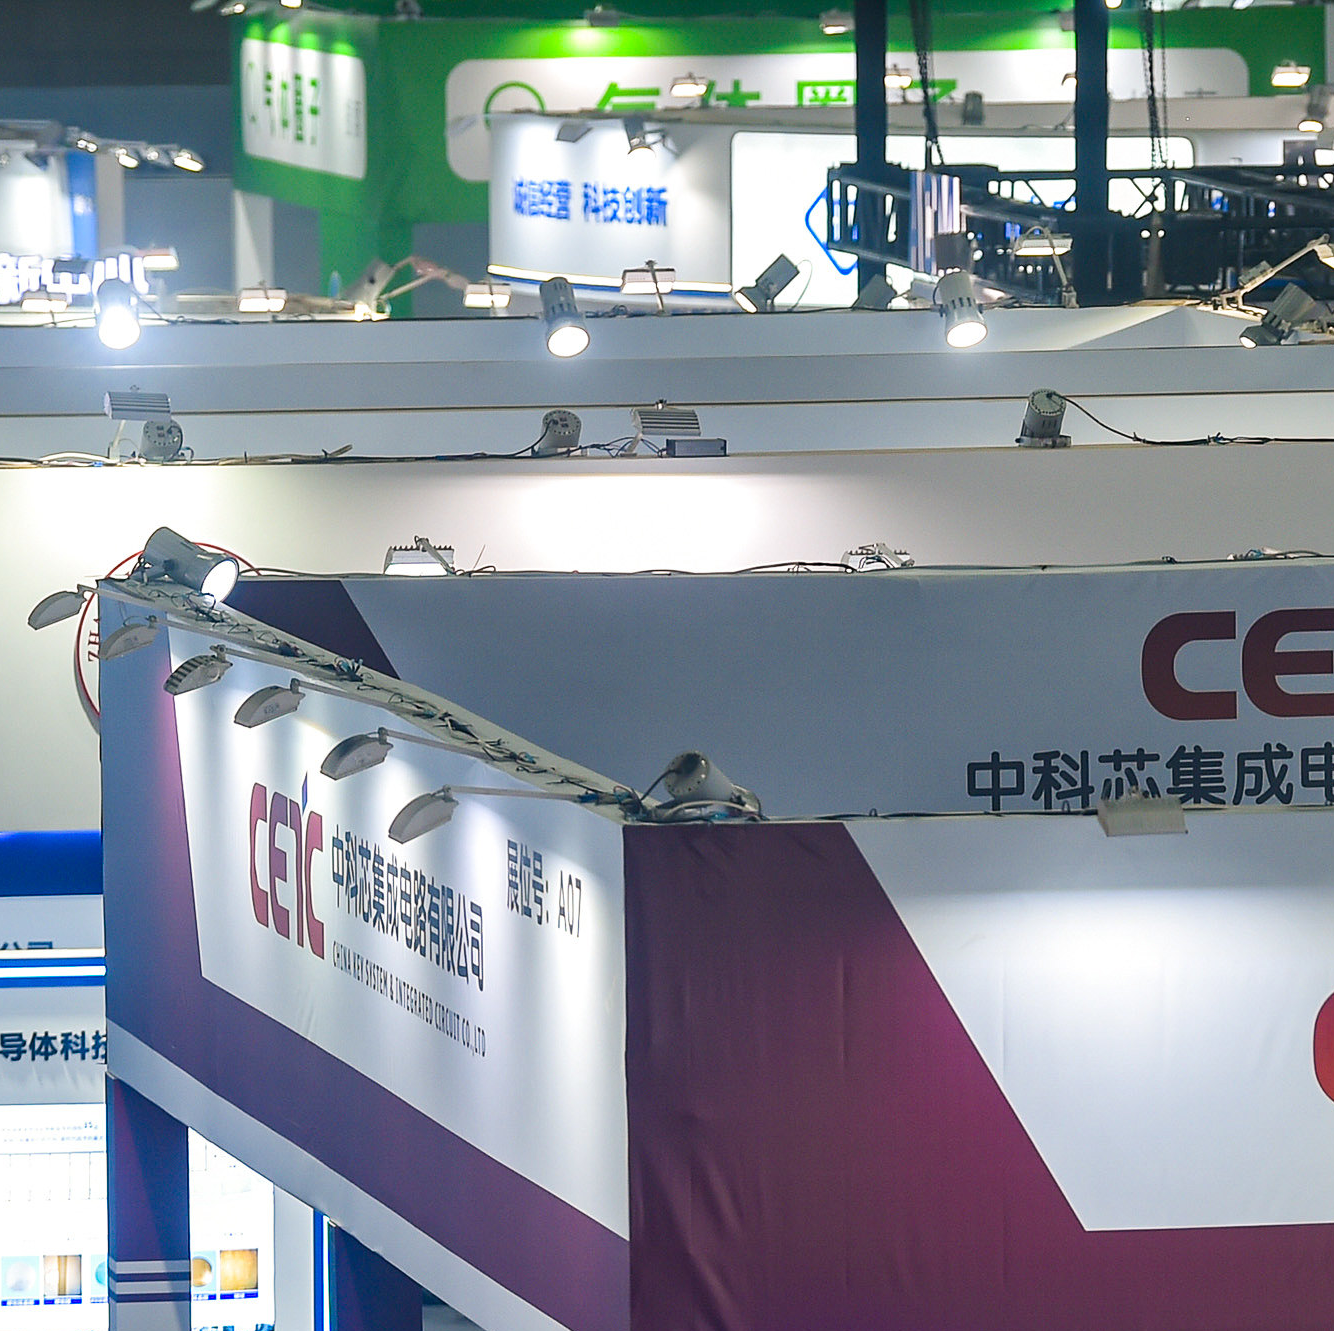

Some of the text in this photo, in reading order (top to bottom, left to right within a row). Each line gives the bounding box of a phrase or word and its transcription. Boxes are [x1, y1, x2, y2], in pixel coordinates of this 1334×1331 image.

[249, 778, 325, 960] CETC
[330, 823, 485, 993] 中科芯集成电路有限公司
[558, 869, 583, 938] A07
[332, 940, 352, 976] CHINA
[365, 959, 388, 997] SYSTEM
[395, 976, 434, 1025] INTEGRATED
[434, 1001, 460, 1042] CIRCUIT
